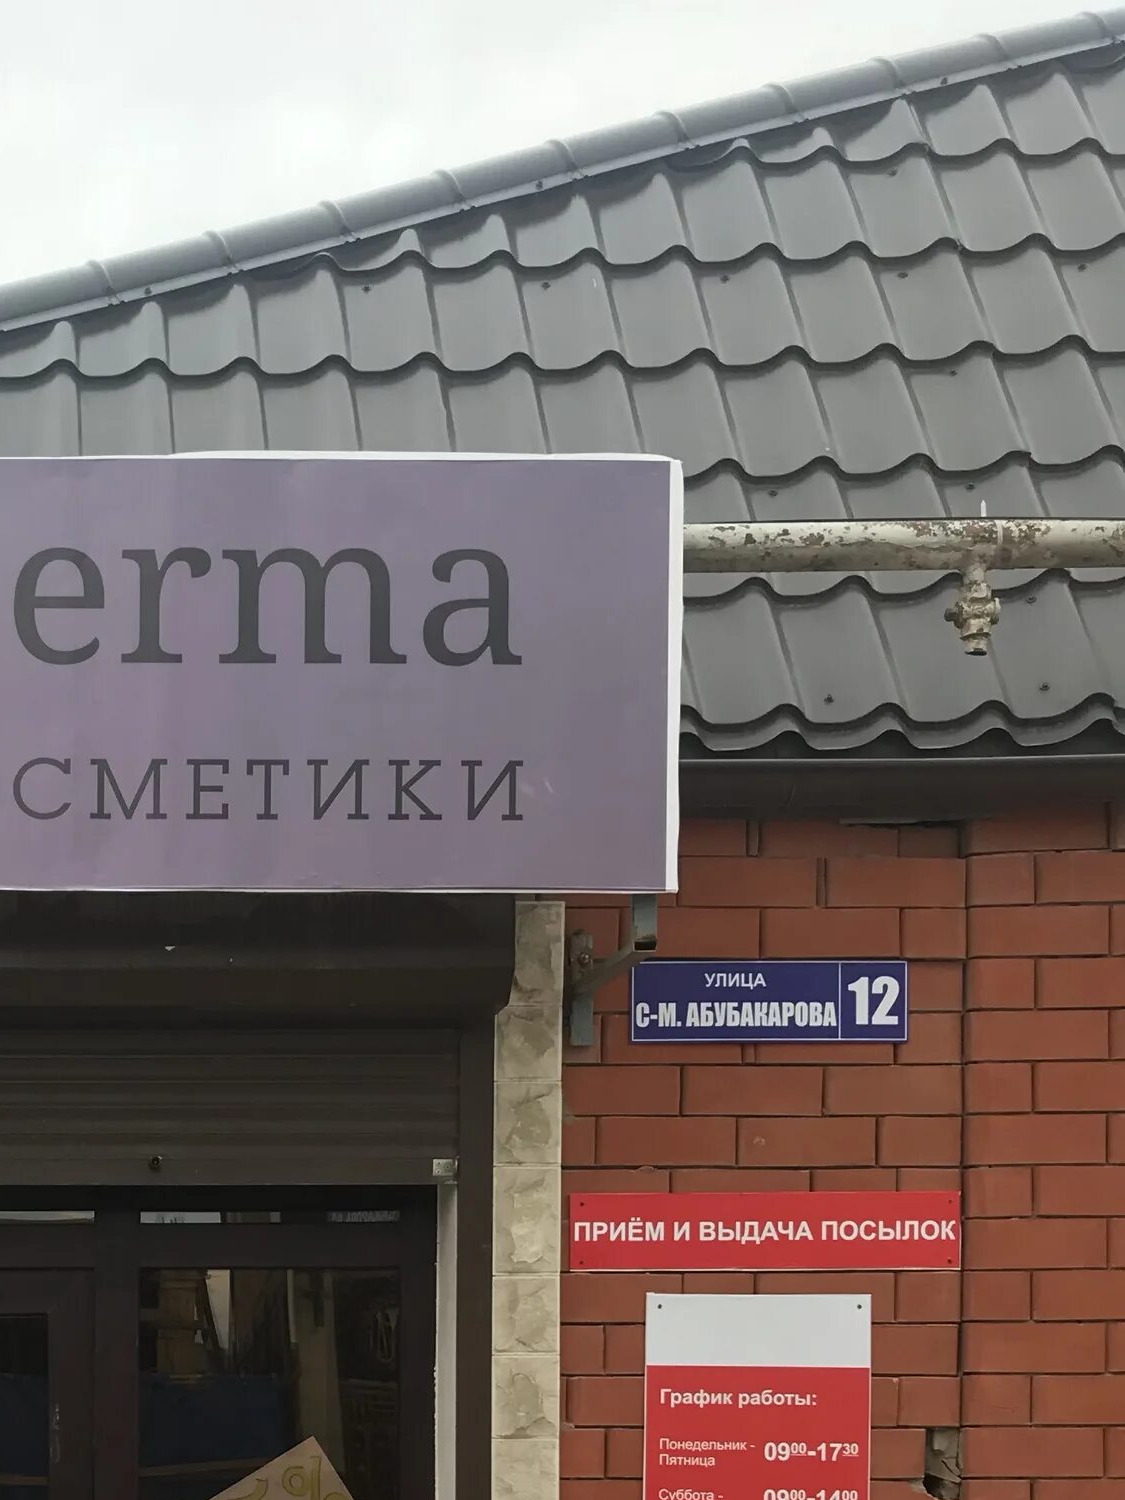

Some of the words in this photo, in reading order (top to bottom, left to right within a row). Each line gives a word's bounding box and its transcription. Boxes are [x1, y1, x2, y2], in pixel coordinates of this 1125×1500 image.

[704, 972, 767, 990] УЛИЦА
[847, 975, 900, 1025] 12
[635, 1002, 682, 1028] С-М.
[685, 1001, 838, 1027] АБУБАКАРОВА
[574, 1216, 665, 1242] ПРИЁМ
[673, 1221, 691, 1242] И
[699, 1220, 814, 1245] ВЫДАЧА
[821, 1219, 956, 1241] ПОСЫЛОК
[660, 1388, 733, 1409] График
[738, 1389, 817, 1409] работы:
[659, 1437, 748, 1452] Понедельник
[659, 1453, 716, 1468] Пятница
